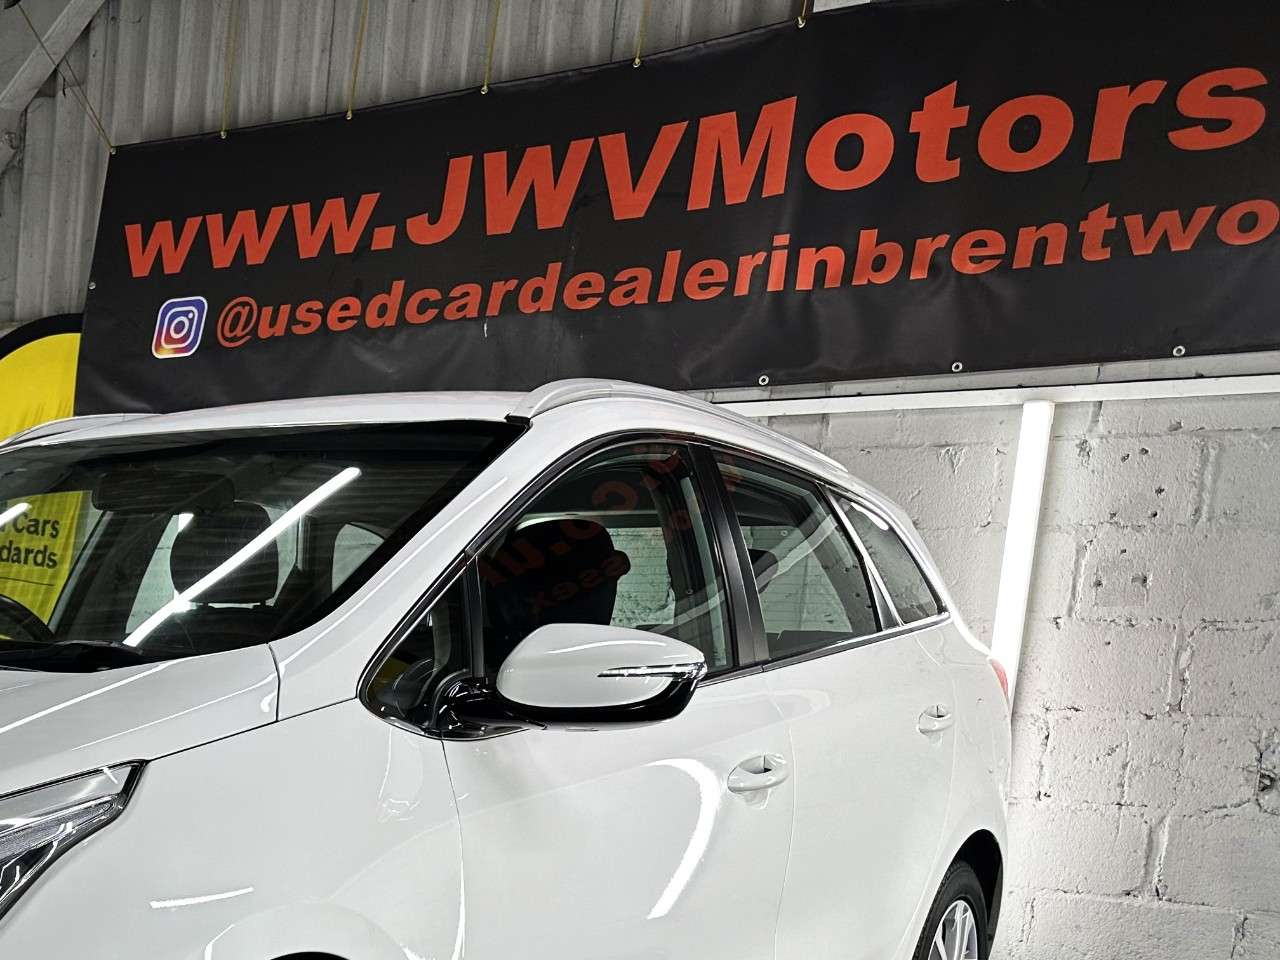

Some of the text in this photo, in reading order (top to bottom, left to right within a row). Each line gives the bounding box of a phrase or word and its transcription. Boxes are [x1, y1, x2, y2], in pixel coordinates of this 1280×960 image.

[124, 67, 1269, 278] www.JWVMotors
[216, 199, 1280, 349] @usedcardealerinbrentwo
[12, 512, 60, 539] Cars
